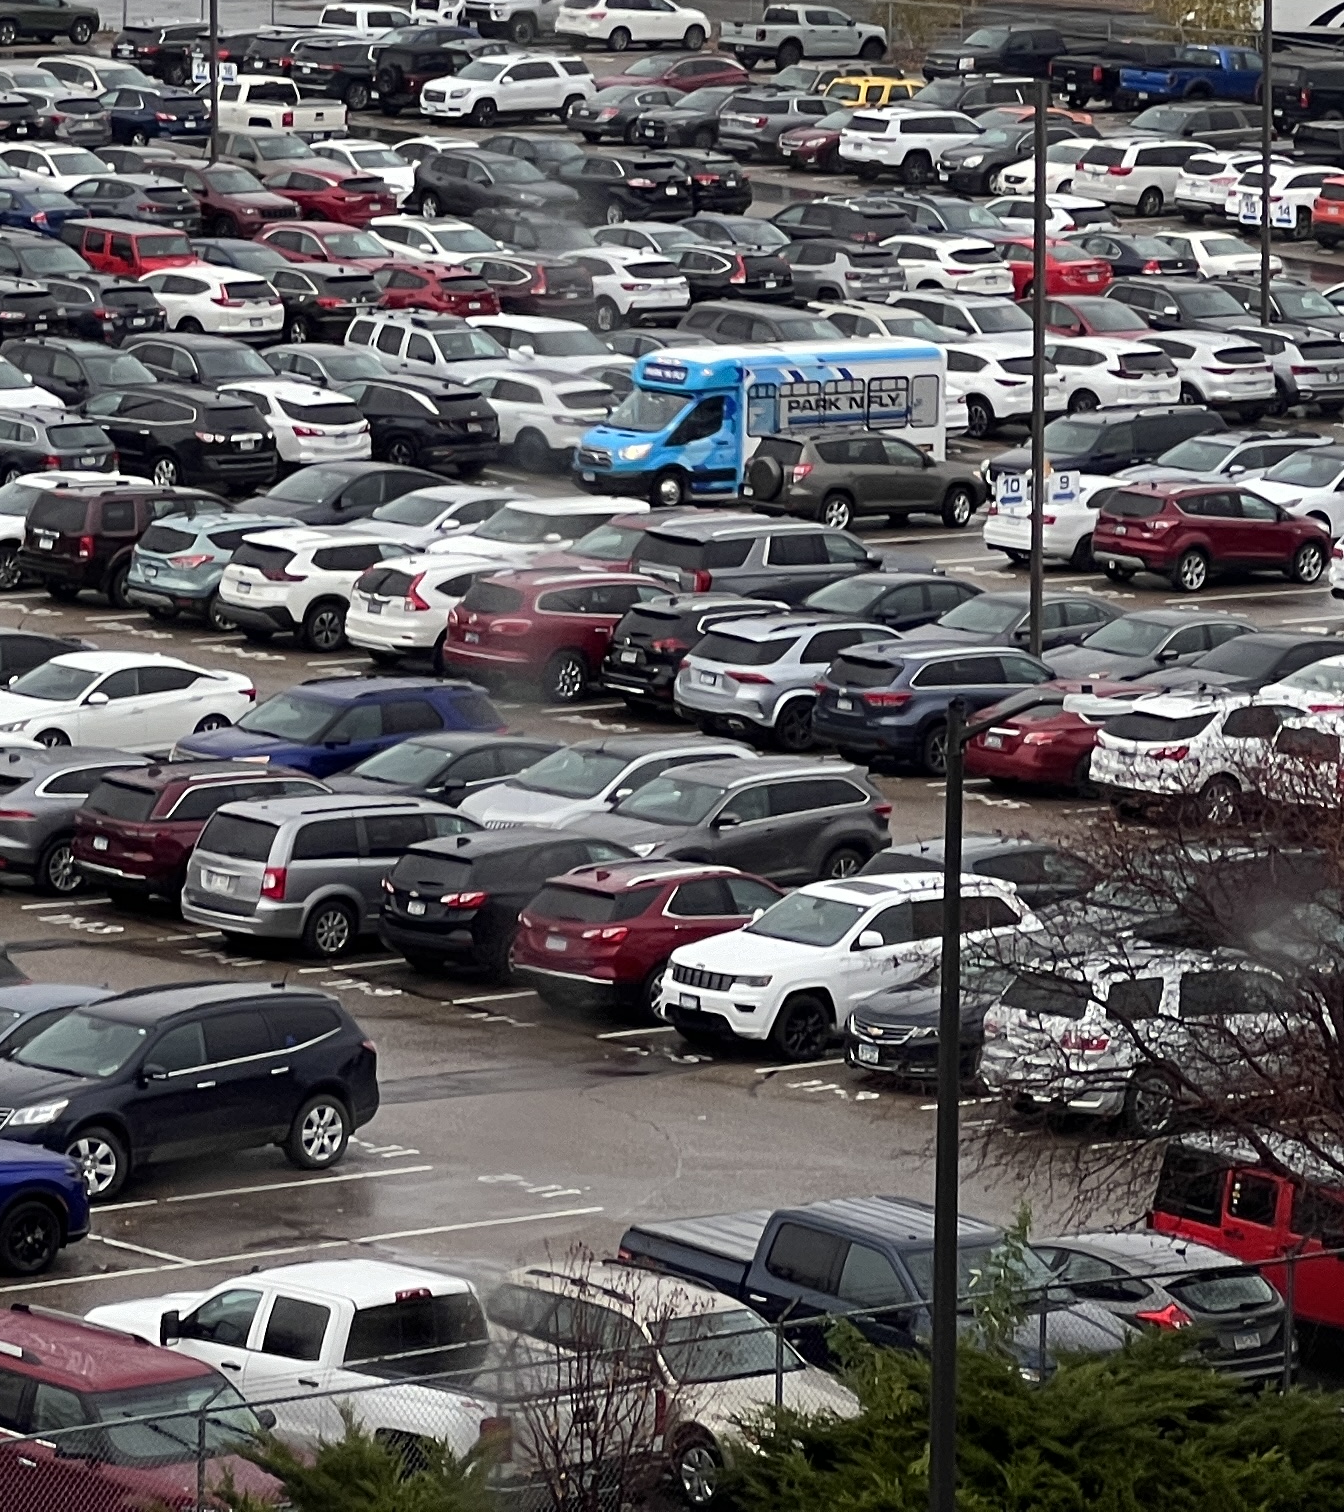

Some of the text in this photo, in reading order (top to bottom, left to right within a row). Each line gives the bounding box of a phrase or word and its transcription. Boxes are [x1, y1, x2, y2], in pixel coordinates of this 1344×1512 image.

[788, 397, 841, 413] PARK
[867, 393, 899, 408] FLY
[1003, 478, 1020, 494] 10
[1059, 475, 1069, 490] 9
